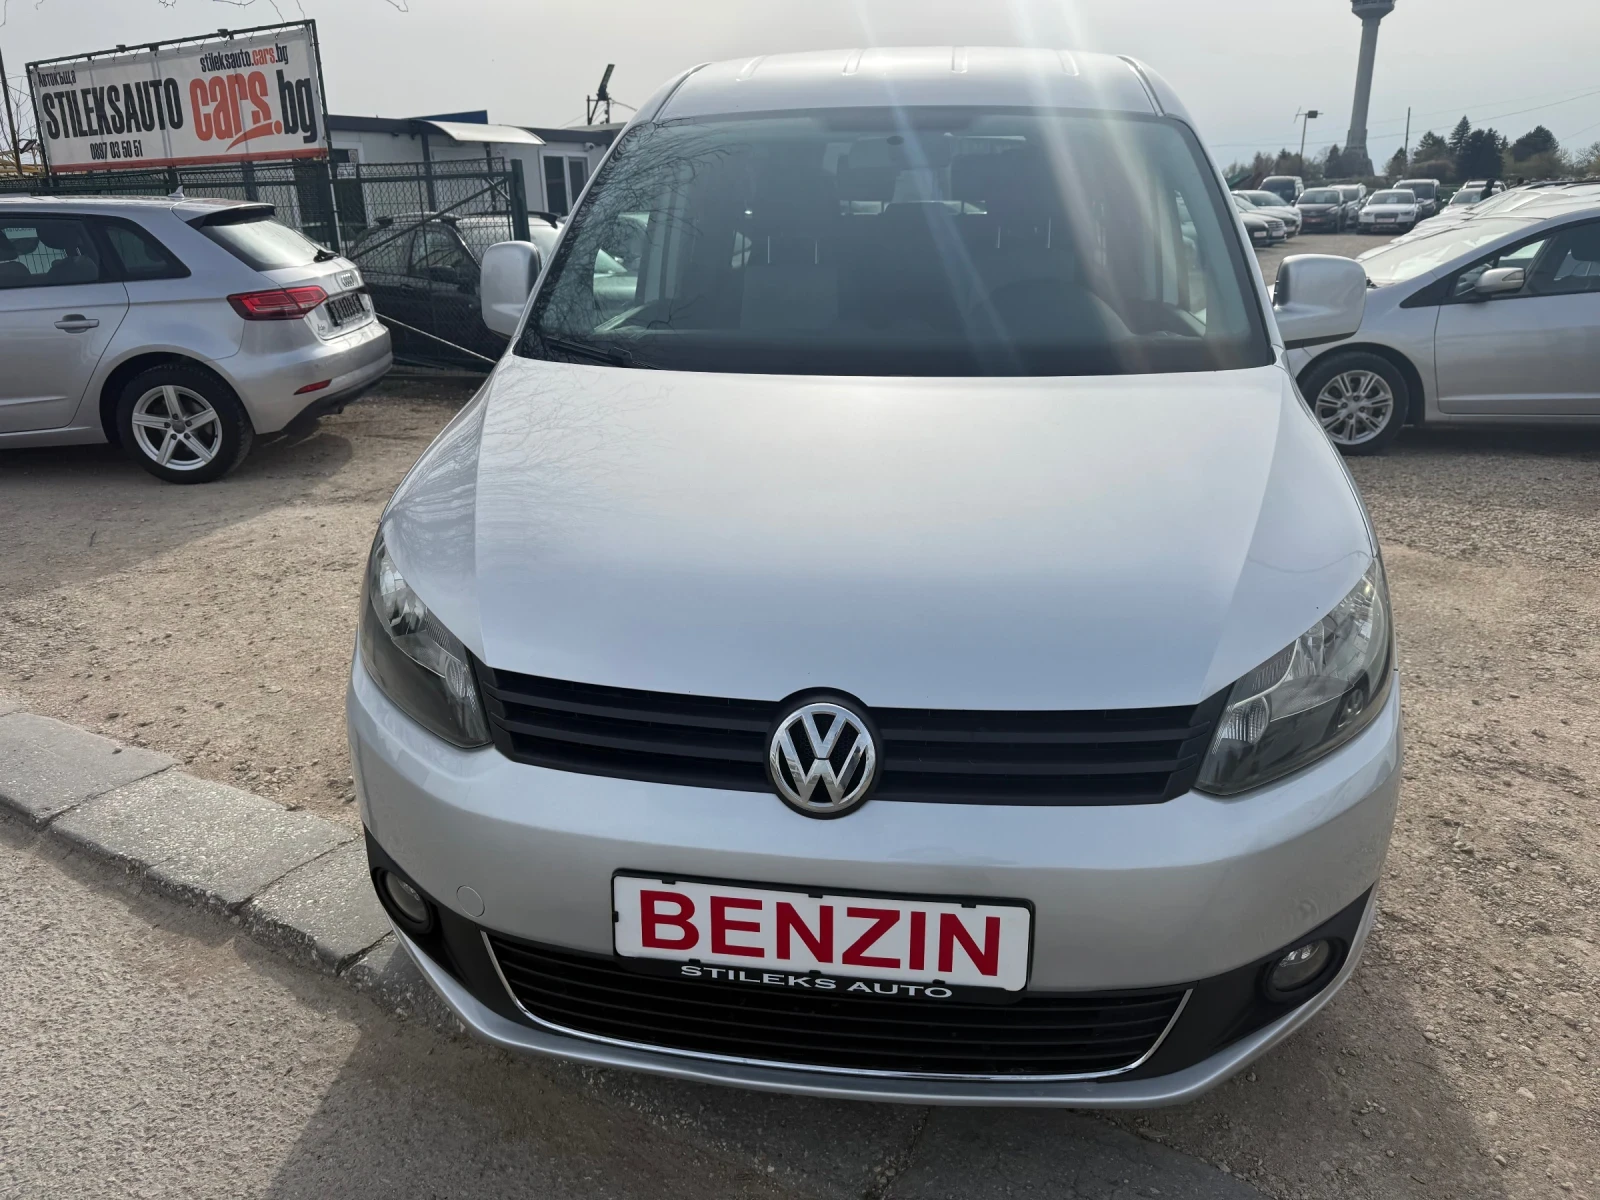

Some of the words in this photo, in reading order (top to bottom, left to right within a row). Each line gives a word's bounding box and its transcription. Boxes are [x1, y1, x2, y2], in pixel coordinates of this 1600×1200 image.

[200, 43, 288, 72] stileksauto.cars.bg
[37, 70, 76, 87] Автокъща
[42, 77, 183, 139] STILEKSAUTO
[109, 141, 121, 159] 03
[121, 140, 133, 158] 50
[132, 139, 143, 157] 51
[639, 889, 1001, 977] BENZIN
[680, 965, 837, 990] STILEKS
[848, 980, 953, 999] AUTO
